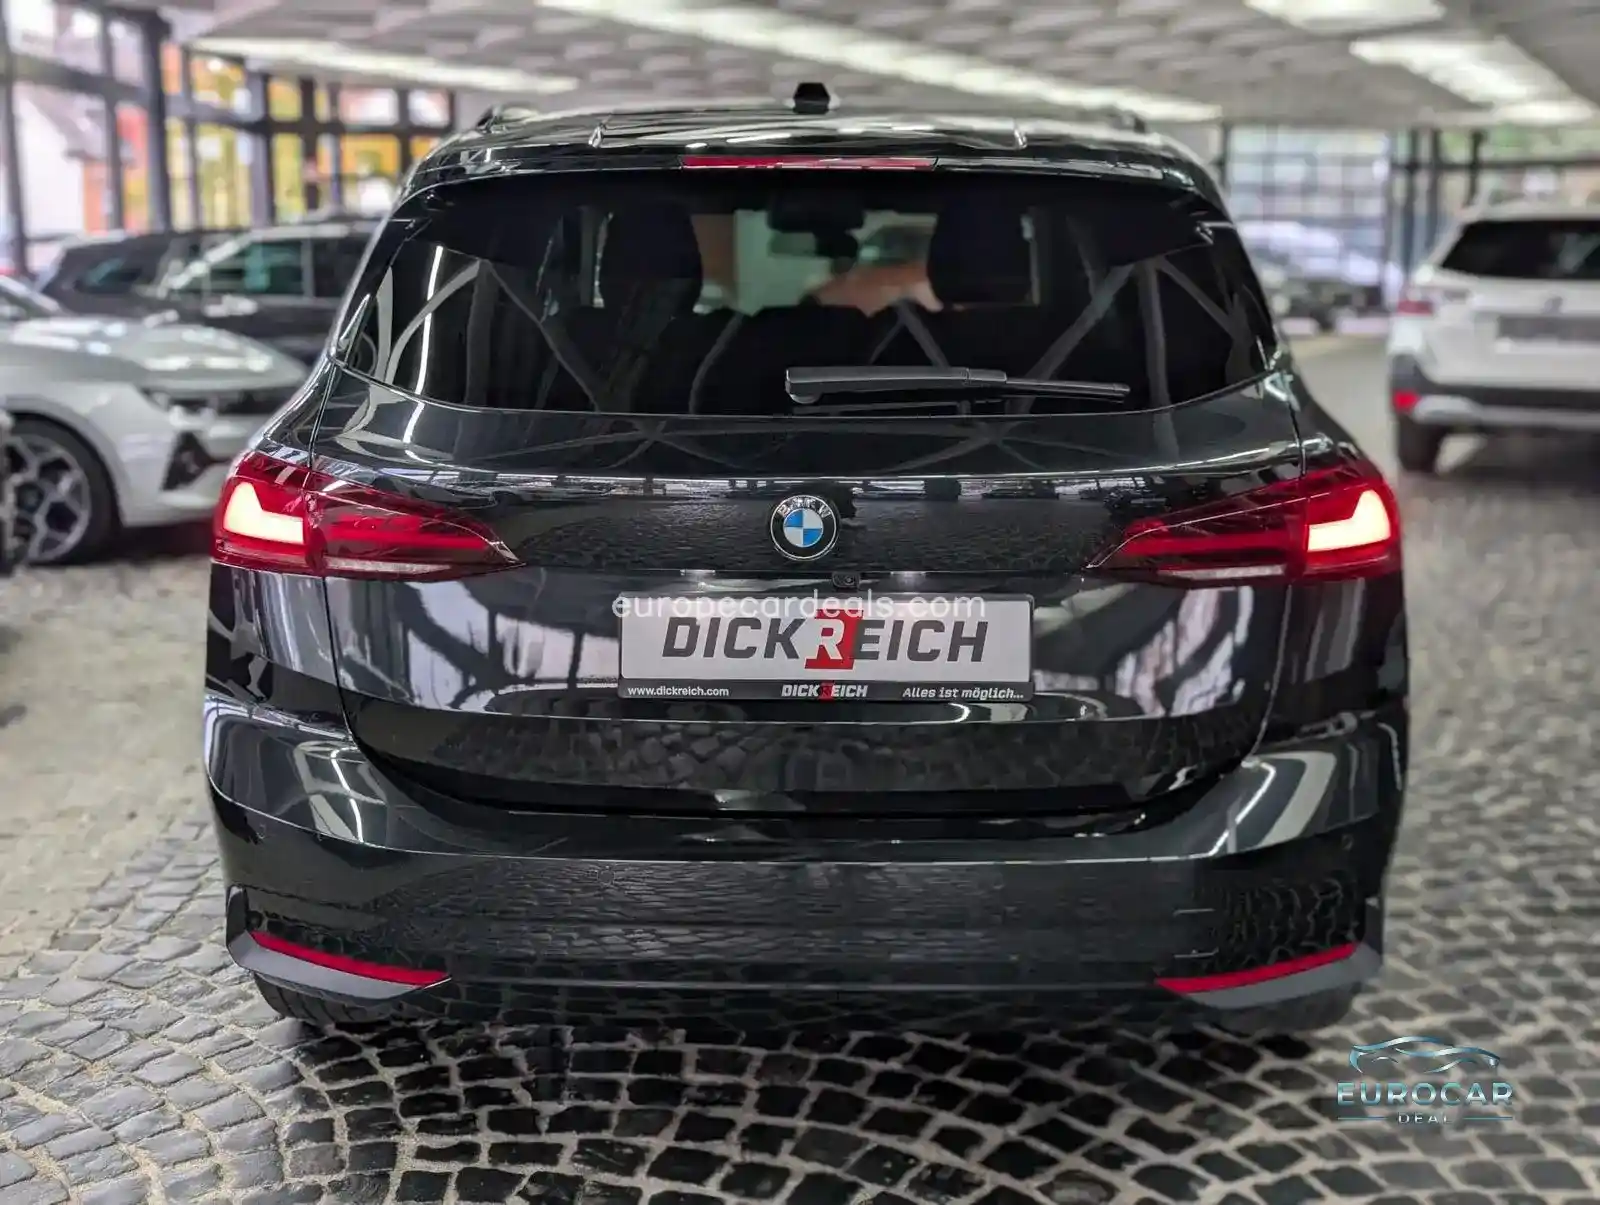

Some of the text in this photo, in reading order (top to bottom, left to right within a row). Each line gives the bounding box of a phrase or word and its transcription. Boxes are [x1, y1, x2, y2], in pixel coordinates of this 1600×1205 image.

[661, 608, 989, 670] DICKREICH
[627, 685, 730, 697] www.dickreich.com
[902, 687, 1024, 701] Alles ist möglich...
